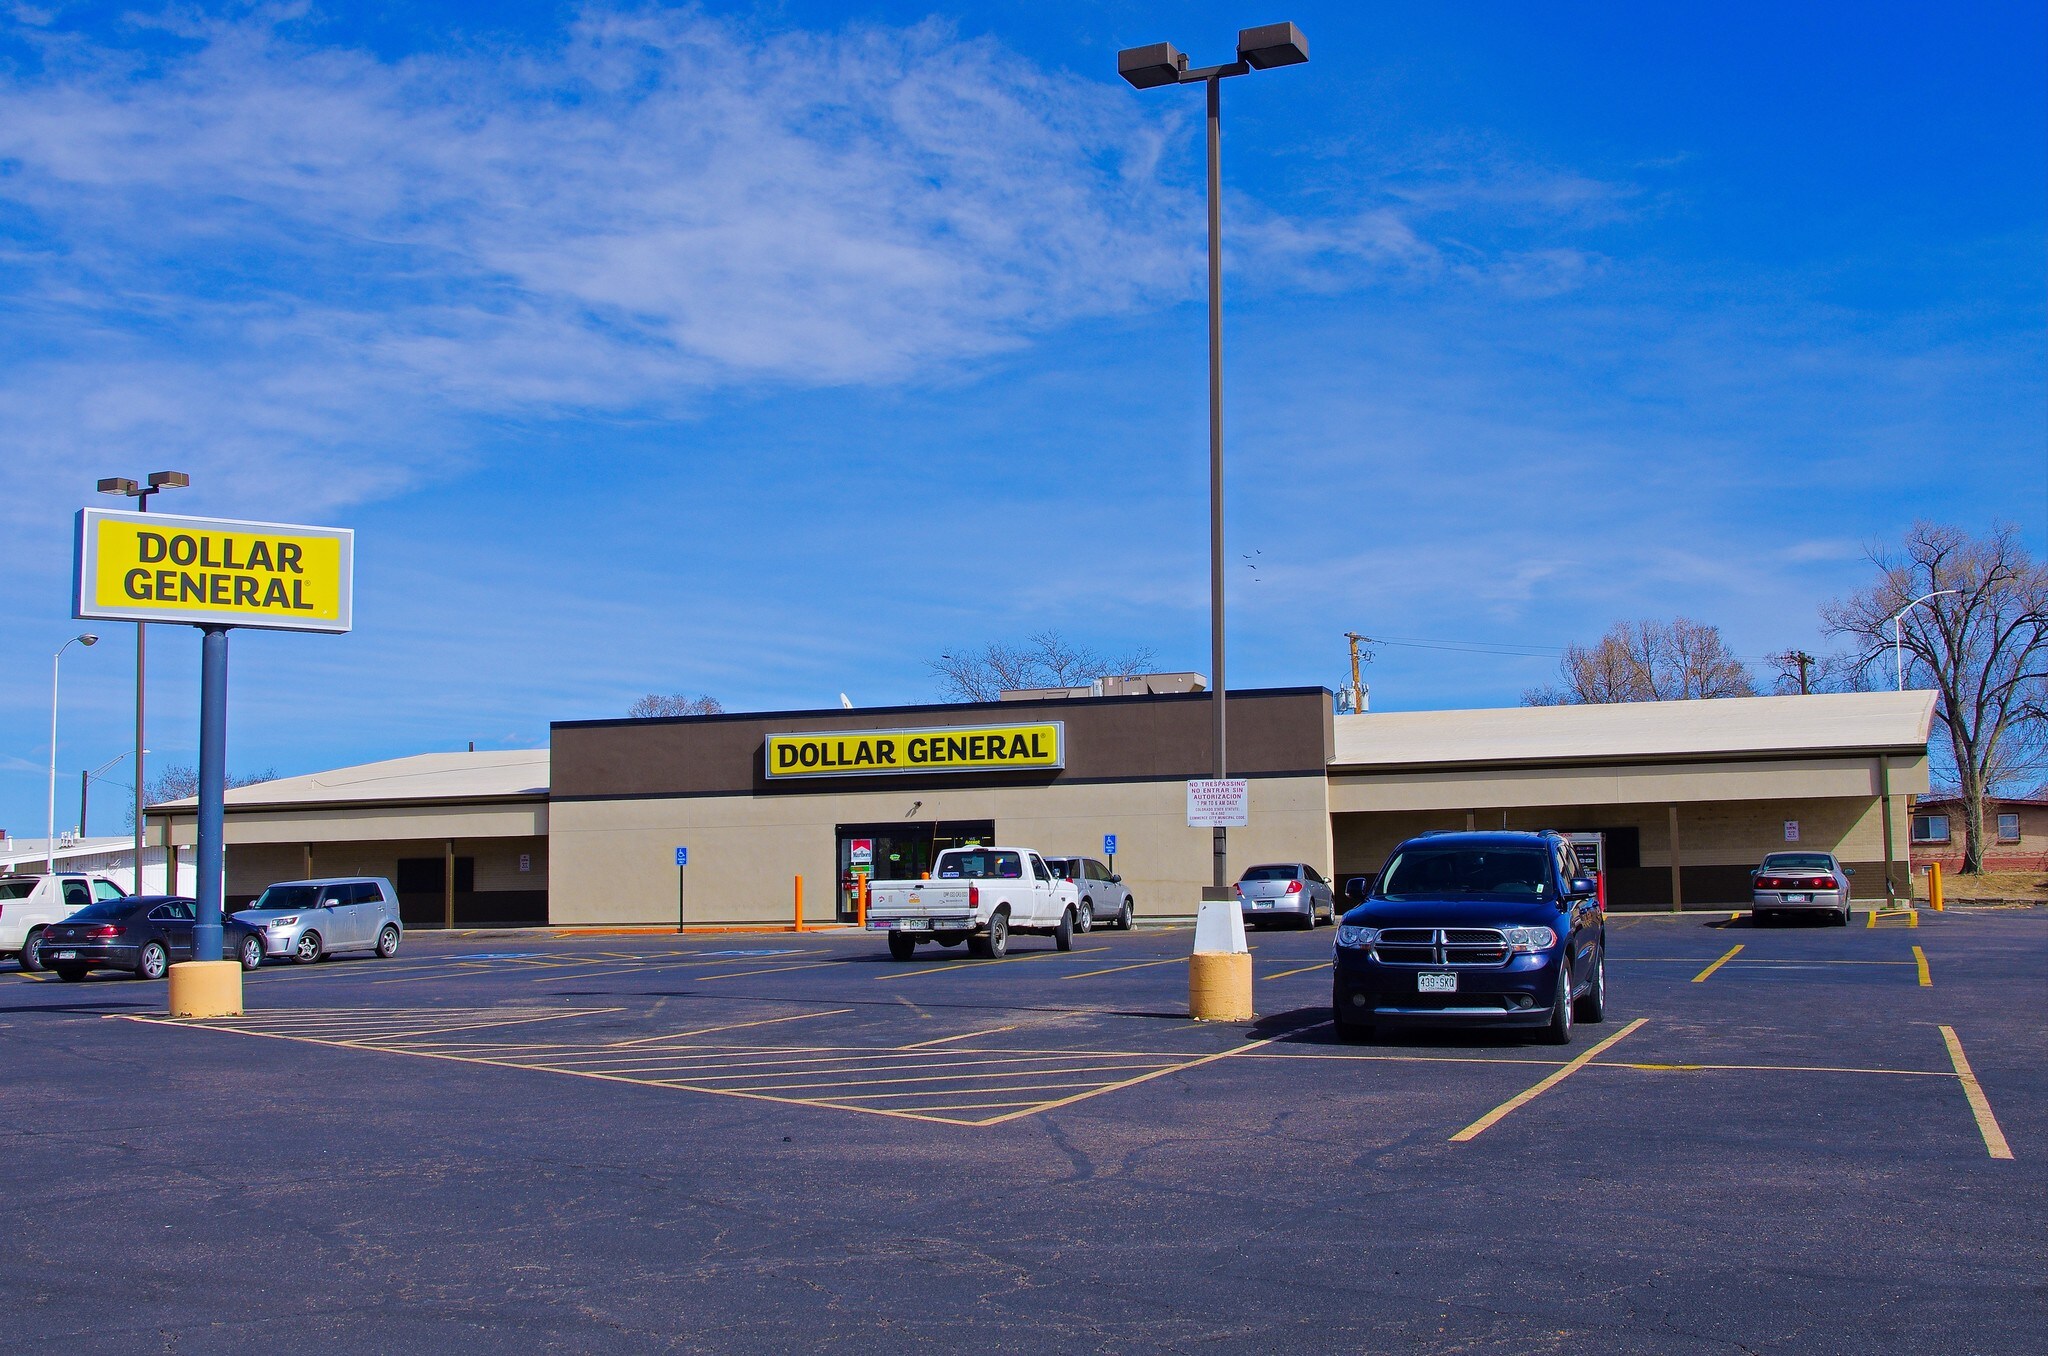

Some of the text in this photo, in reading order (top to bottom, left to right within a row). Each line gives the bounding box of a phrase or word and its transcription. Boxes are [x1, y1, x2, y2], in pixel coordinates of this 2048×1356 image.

[136, 531, 304, 574] DOLLAR
[124, 567, 314, 610] GENERAL
[777, 733, 1048, 768] DOLLAR GENERAL
